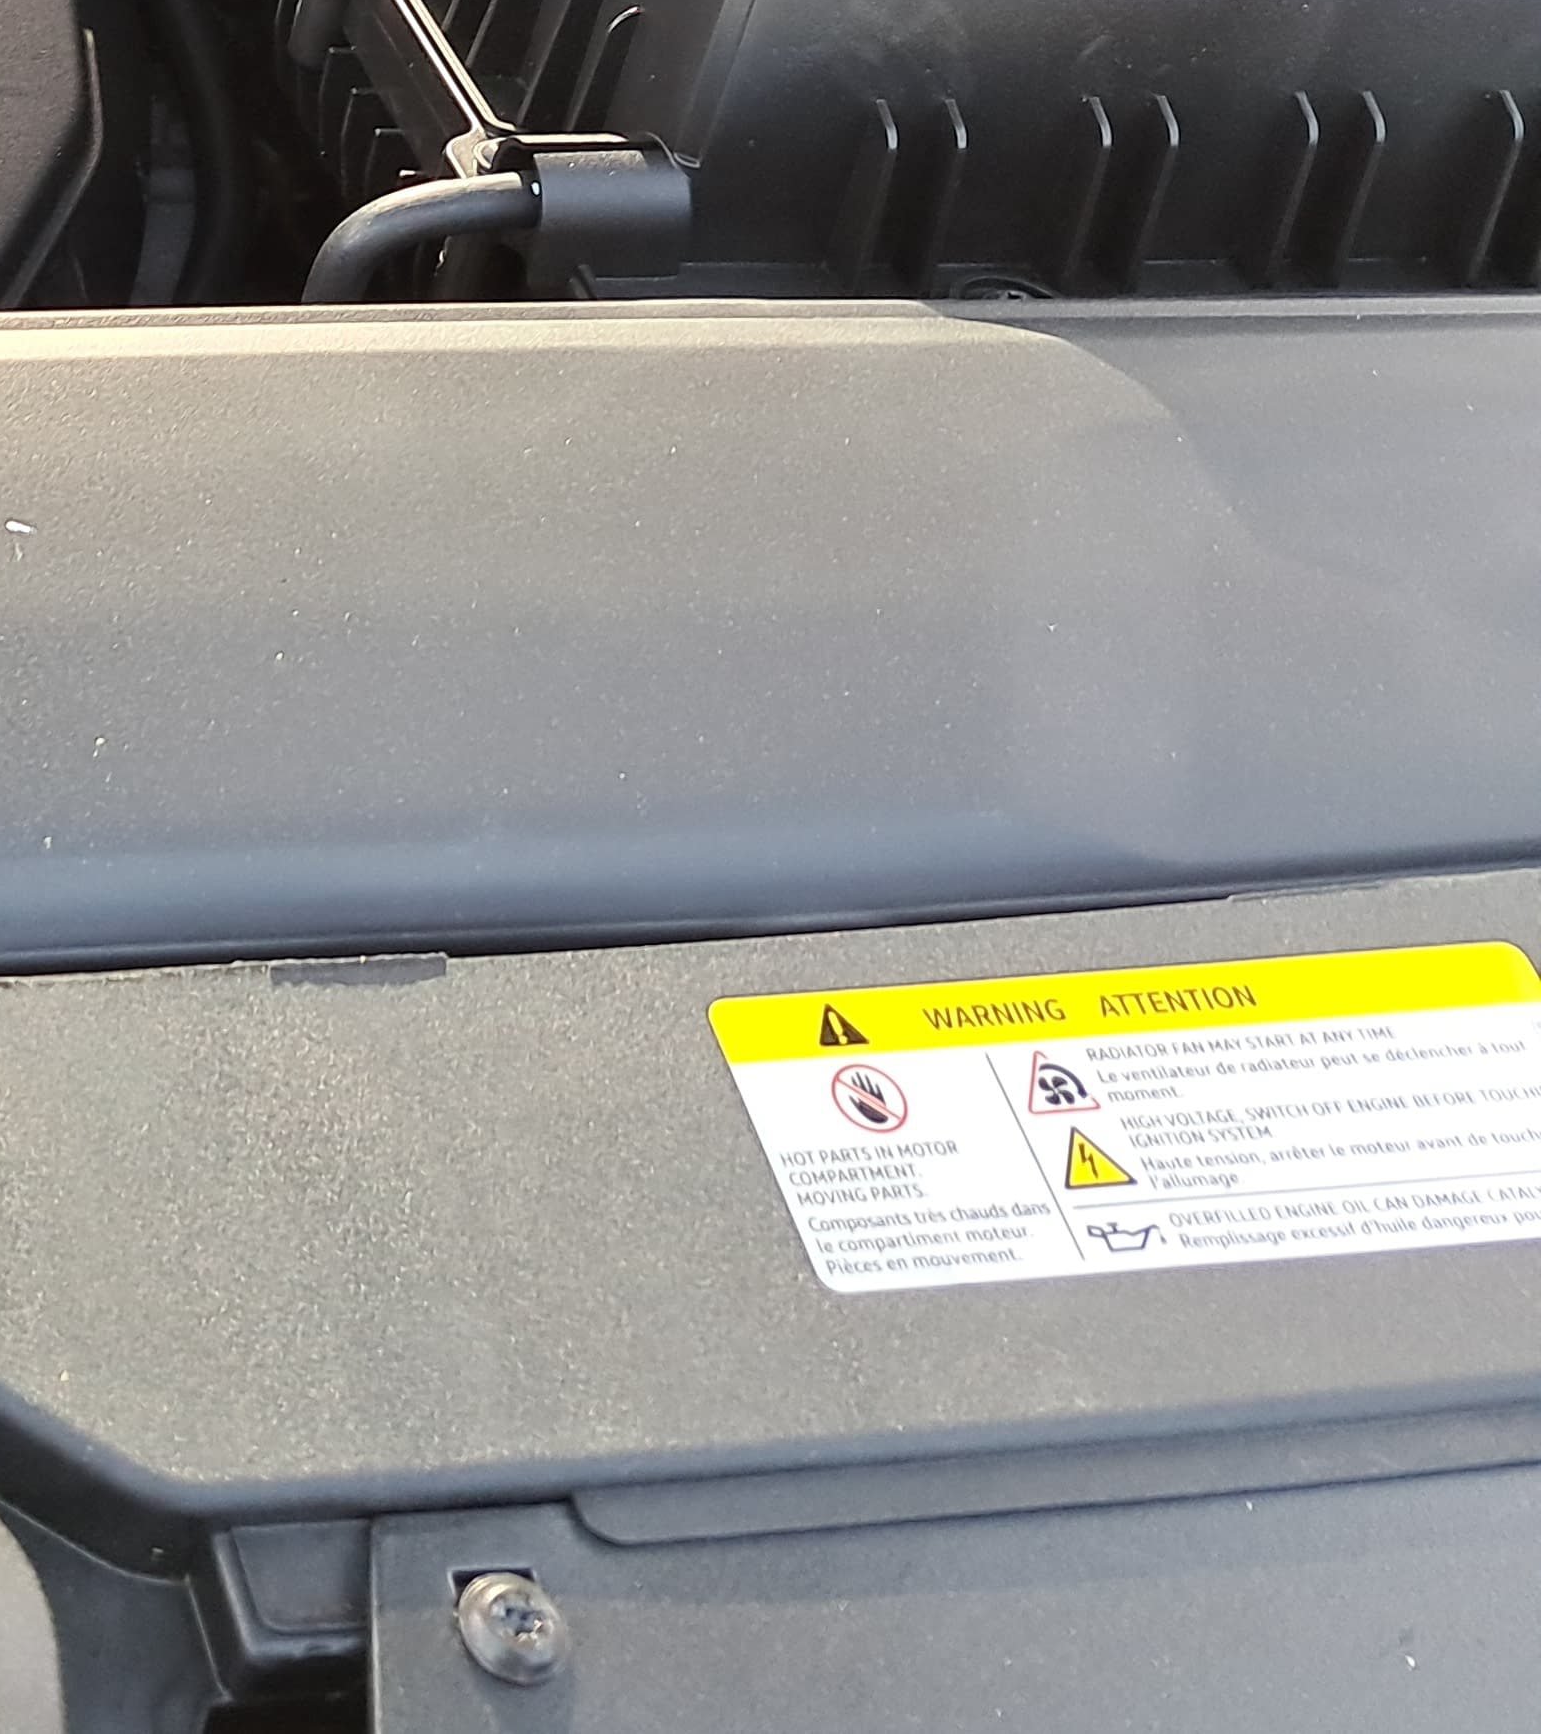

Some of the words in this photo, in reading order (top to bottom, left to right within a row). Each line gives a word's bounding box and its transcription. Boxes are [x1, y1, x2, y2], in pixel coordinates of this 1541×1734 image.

[922, 998, 1066, 1031] WARNING
[1099, 985, 1258, 1018] ATTENTION
[1086, 1043, 1168, 1062] RADIATOR
[1172, 1040, 1205, 1055] FAN
[1208, 1037, 1242, 1053] MAY
[1245, 1033, 1295, 1050] START
[1300, 1031, 1318, 1045] AT
[1322, 1028, 1354, 1043] ANY
[1358, 1026, 1396, 1040] TIME
[1097, 1069, 1118, 1084] Le
[1121, 1062, 1212, 1081] ventilateur
[1217, 1061, 1238, 1075] de
[1241, 1055, 1316, 1073] radiateur
[1321, 1052, 1358, 1070] peut
[1362, 1051, 1381, 1063] se
[1385, 1044, 1474, 1063] déclencher
[1478, 1042, 1489, 1054] à
[1491, 1040, 1526, 1054] tout
[1120, 1114, 1163, 1131] HIGH
[1245, 1102, 1309, 1122] SWITCH
[1312, 1100, 1343, 1115] OFF
[1347, 1095, 1410, 1113] ENGINE
[1413, 1092, 1476, 1109] BEFORE
[779, 1150, 815, 1168] HOT
[819, 1147, 872, 1164] PARTS
[875, 1145, 894, 1160] IN
[897, 1140, 960, 1158] MOTOR
[1129, 1129, 1205, 1149] IGNITION
[1140, 1155, 1193, 1173] Haute
[1270, 1144, 1325, 1162] arrêter
[1329, 1144, 1346, 1157] le
[1351, 1138, 1411, 1154] moteur
[1416, 1134, 1463, 1150] avant
[1467, 1131, 1488, 1146] de
[797, 1188, 868, 1207] MOVING
[1168, 1205, 1271, 1228] OVERFILLED
[1275, 1202, 1338, 1220] ENGINE
[1342, 1198, 1369, 1214] OIL
[1373, 1195, 1410, 1212] CAN
[1413, 1190, 1483, 1208] DAMAGE
[808, 1212, 912, 1236] Composants
[915, 1209, 947, 1225] très
[950, 1204, 1008, 1222] chauds
[1011, 1201, 1051, 1217] dans
[817, 1238, 834, 1254] le
[837, 1232, 961, 1255] compartiment
[825, 1257, 882, 1277] Pièces
[886, 1258, 908, 1272] en
